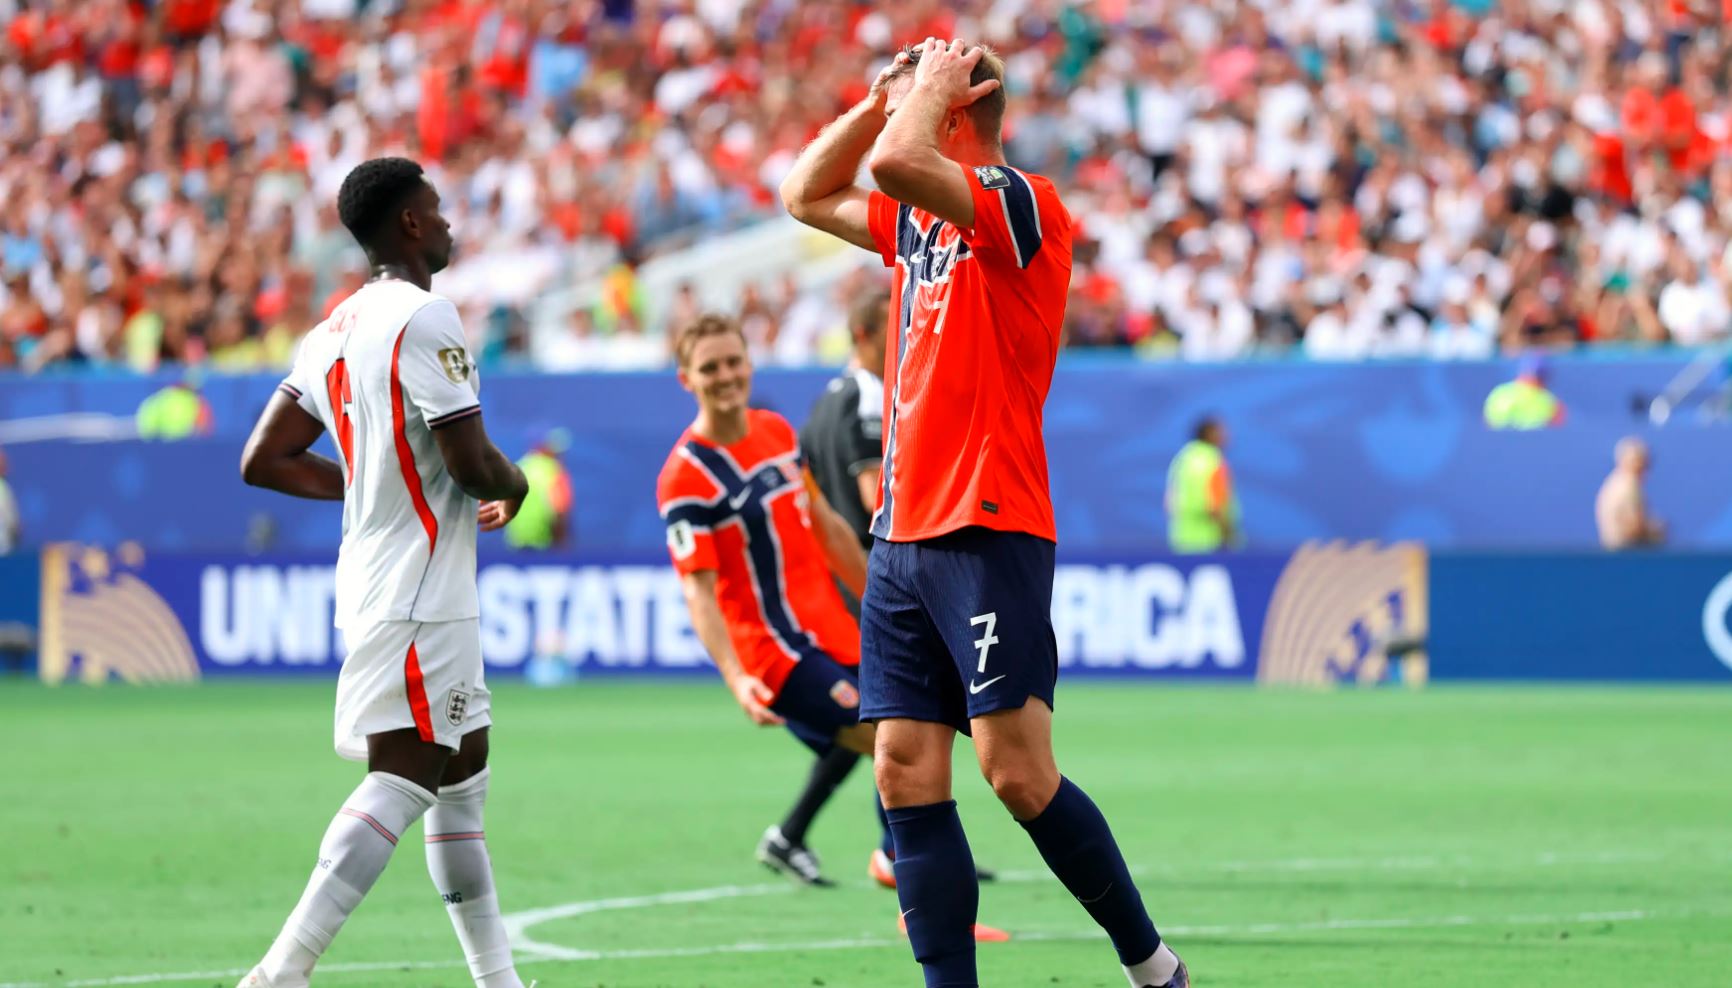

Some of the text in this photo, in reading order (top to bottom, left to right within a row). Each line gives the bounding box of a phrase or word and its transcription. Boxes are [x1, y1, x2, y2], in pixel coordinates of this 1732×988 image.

[475, 563, 716, 668] STATE
[970, 611, 999, 673] 7
[318, 857, 333, 871] NG
